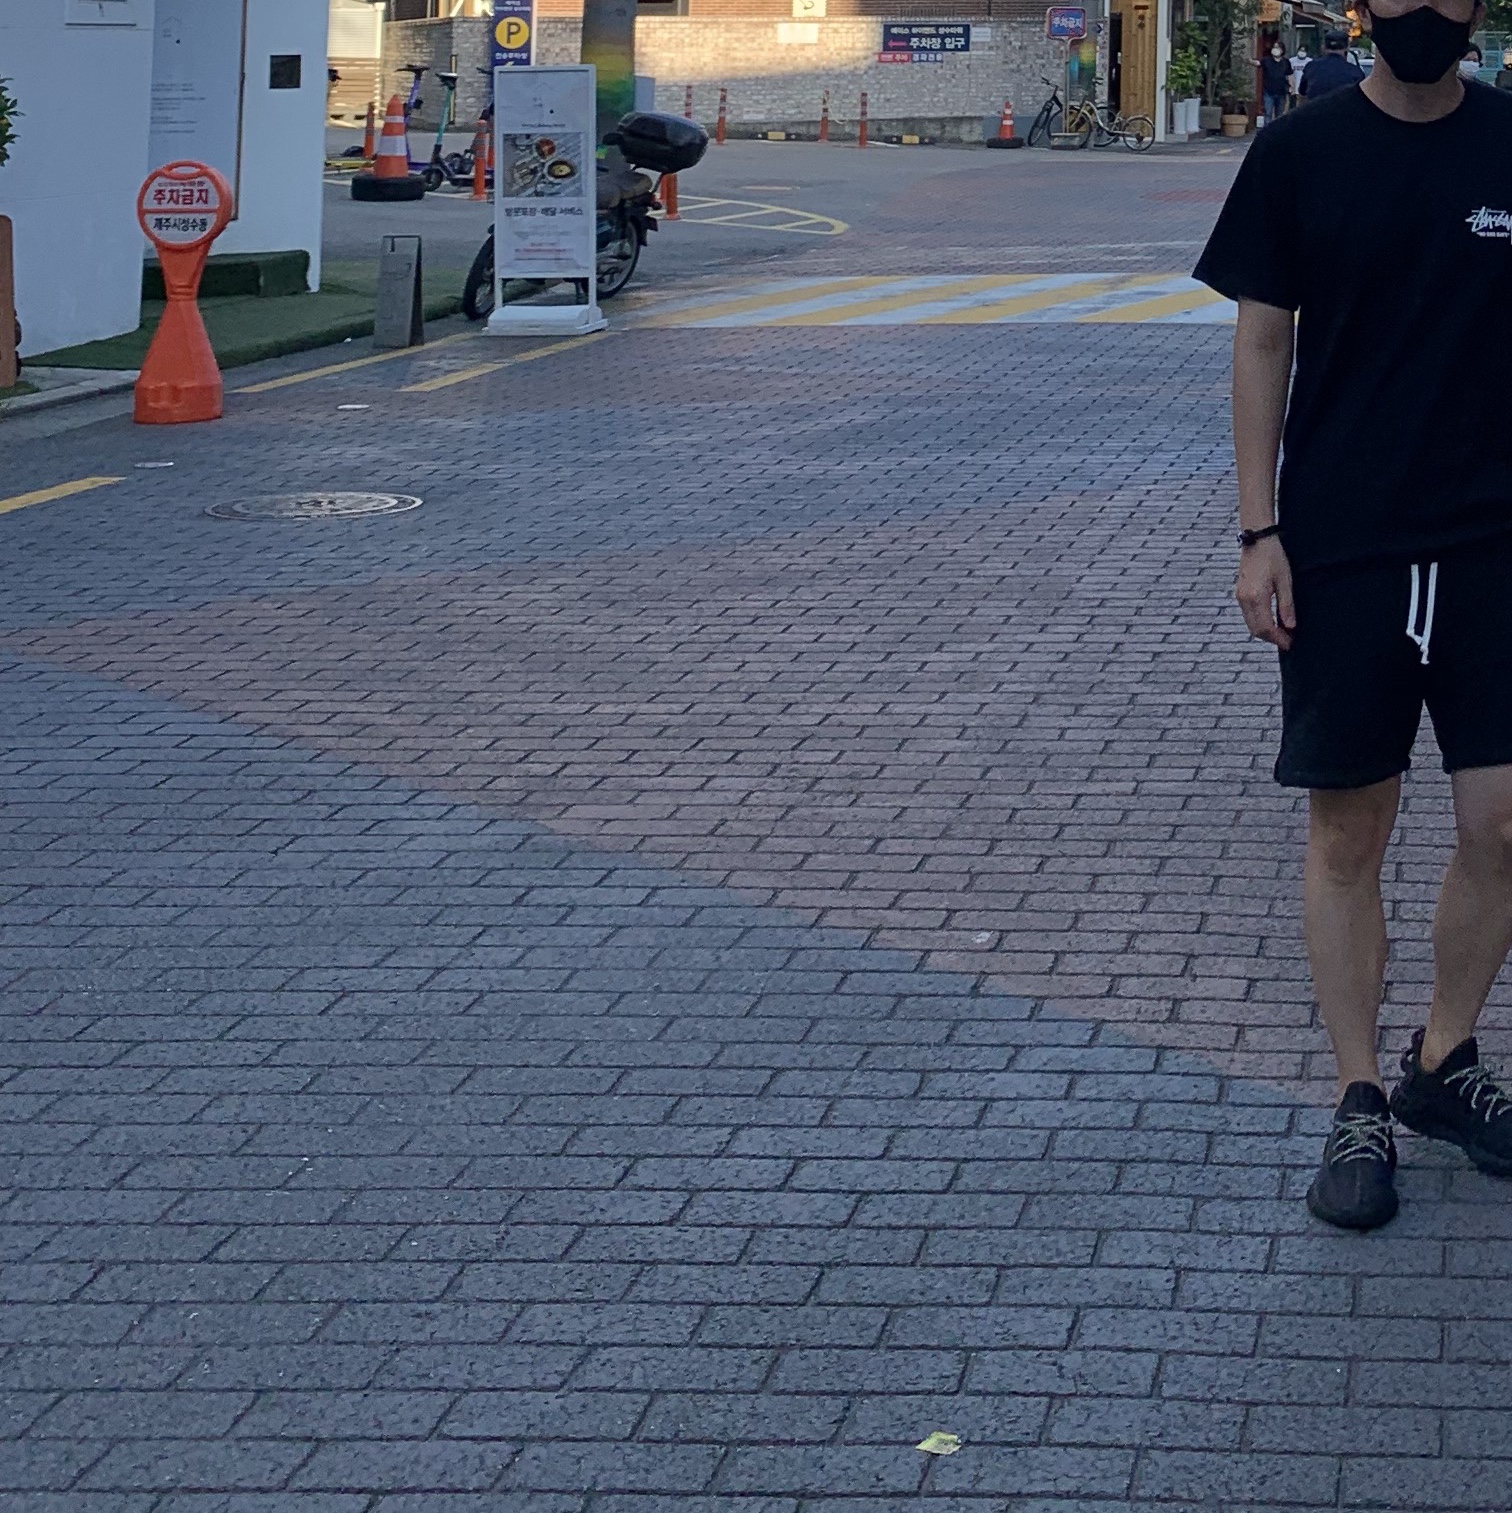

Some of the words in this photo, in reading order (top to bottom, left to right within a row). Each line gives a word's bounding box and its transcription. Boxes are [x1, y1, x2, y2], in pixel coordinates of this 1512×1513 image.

[506, 21, 521, 44] P
[909, 37, 941, 49] 주차장
[944, 37, 966, 49] 입구
[153, 188, 209, 206] 주차금지
[154, 217, 208, 232] 제주시성수동
